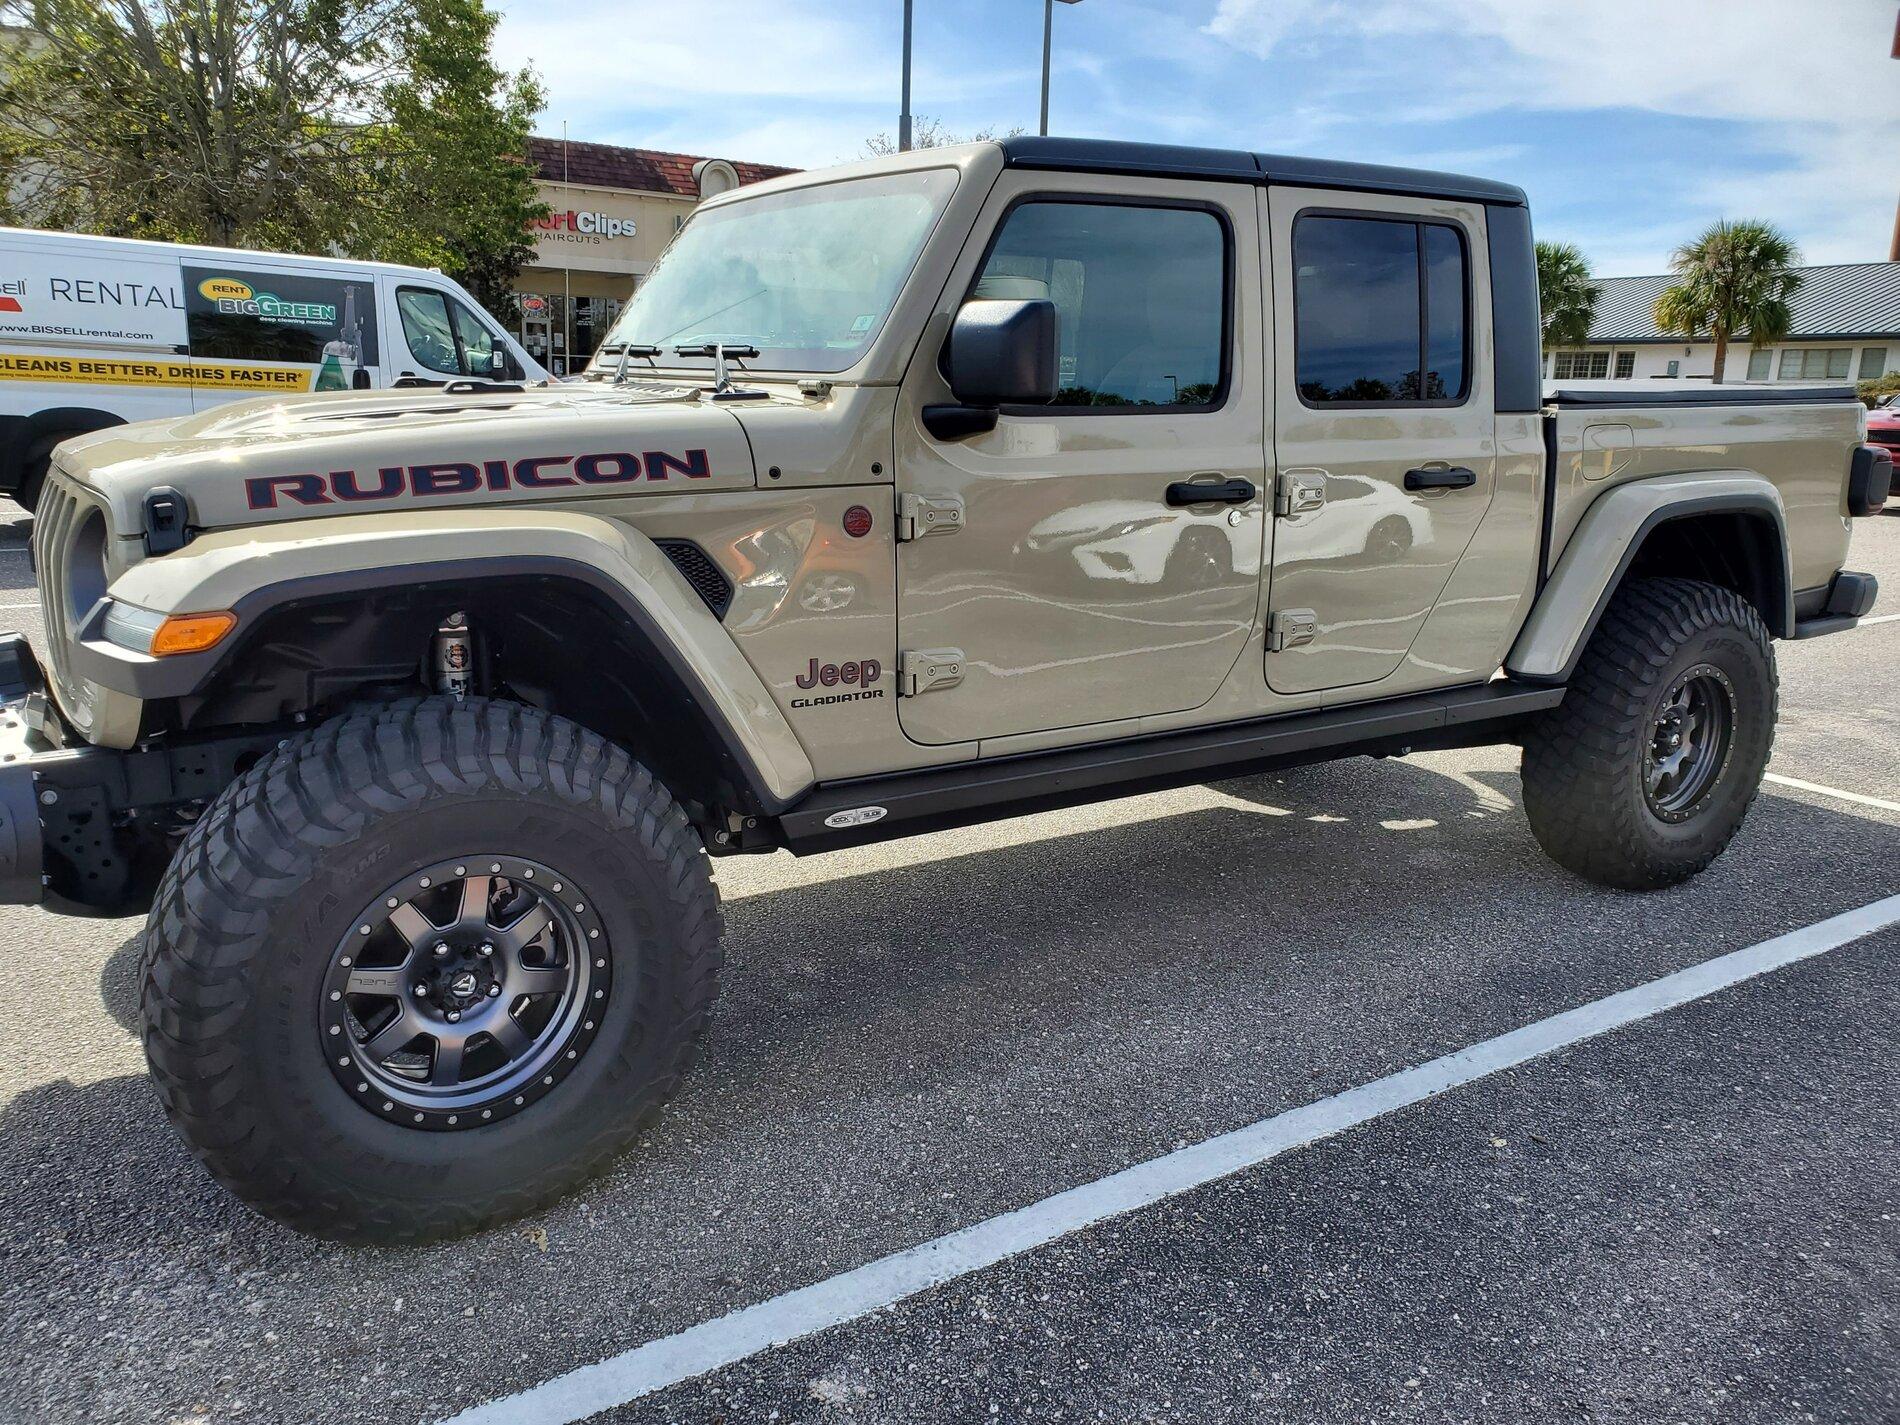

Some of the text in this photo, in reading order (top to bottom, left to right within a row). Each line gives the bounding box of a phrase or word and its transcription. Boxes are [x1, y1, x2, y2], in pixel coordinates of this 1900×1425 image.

[534, 232, 600, 245] HAIRCUTS
[50, 278, 186, 310] RENTAL
[212, 284, 246, 295] RENT
[79, 362, 162, 379] BETTER,
[168, 366, 225, 380] DRIES
[244, 448, 711, 510] RUBICON
[795, 657, 882, 690] Jeep
[790, 689, 885, 709] GLADIATOR
